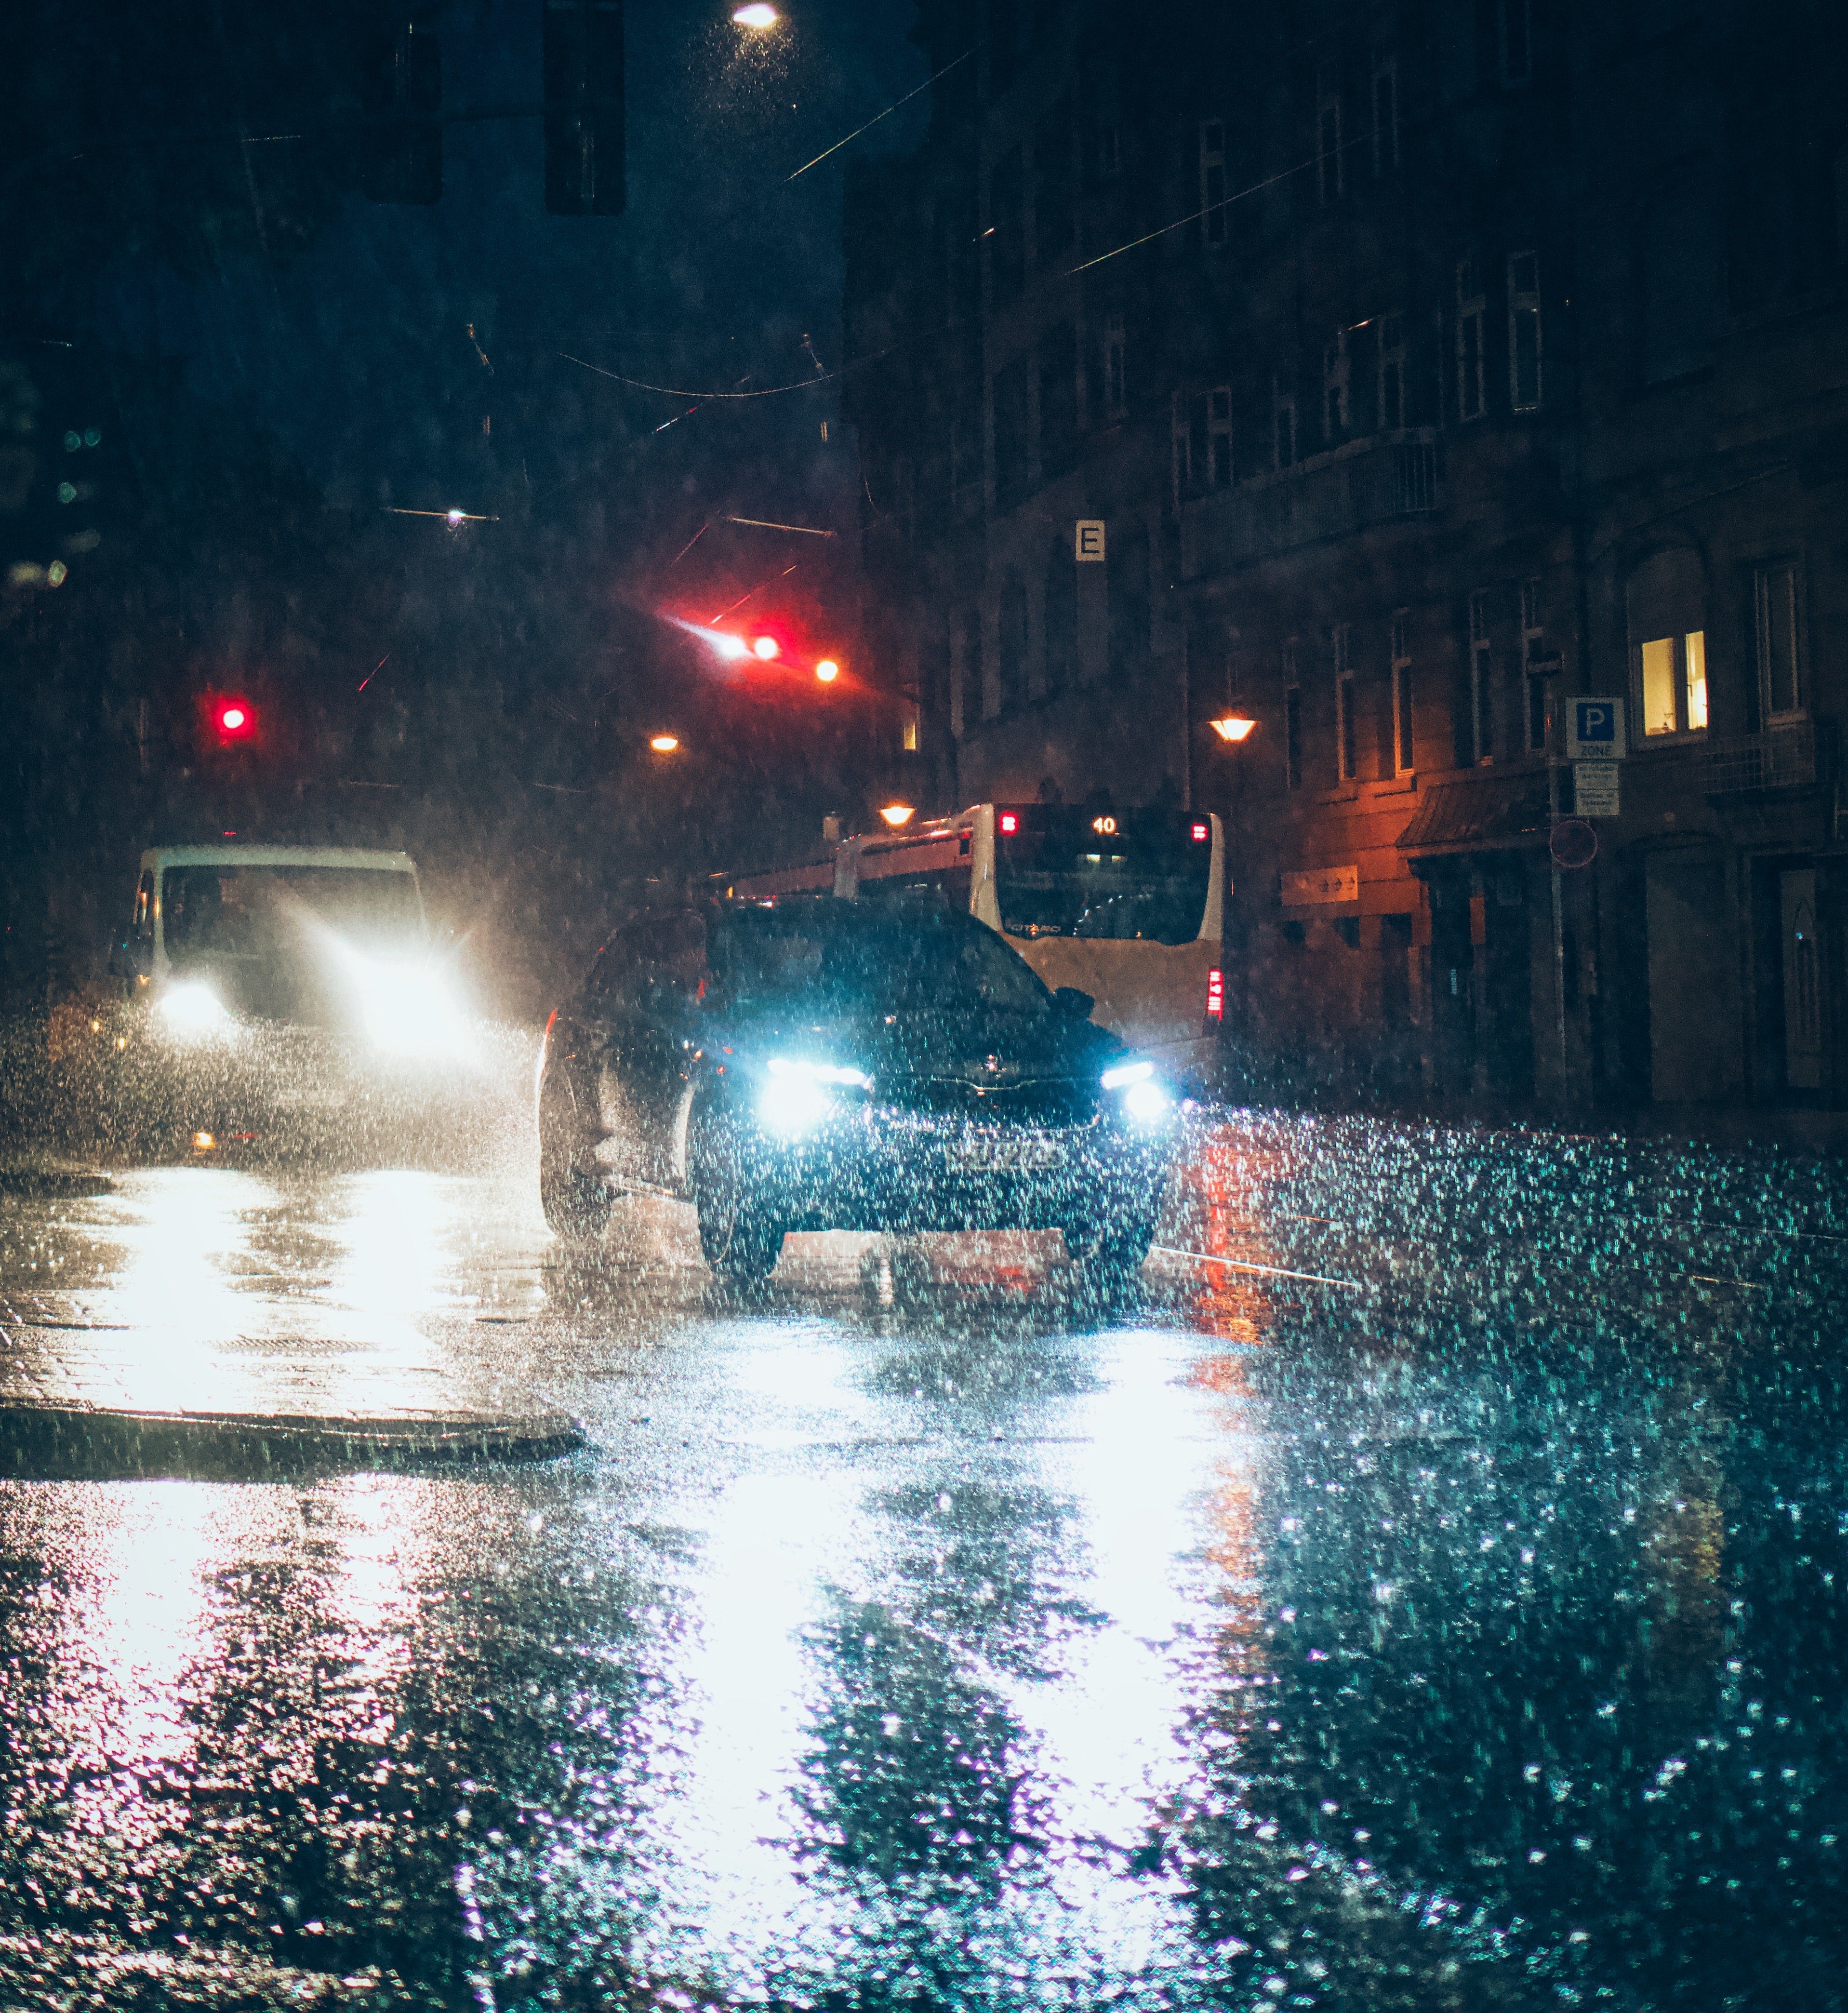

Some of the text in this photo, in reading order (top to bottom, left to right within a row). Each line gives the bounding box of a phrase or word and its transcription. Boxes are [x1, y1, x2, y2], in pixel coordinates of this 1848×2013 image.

[1081, 527, 1099, 554] E
[1586, 708, 1605, 736] P
[1581, 746, 1611, 757] ZONE
[1093, 817, 1116, 833] 40
